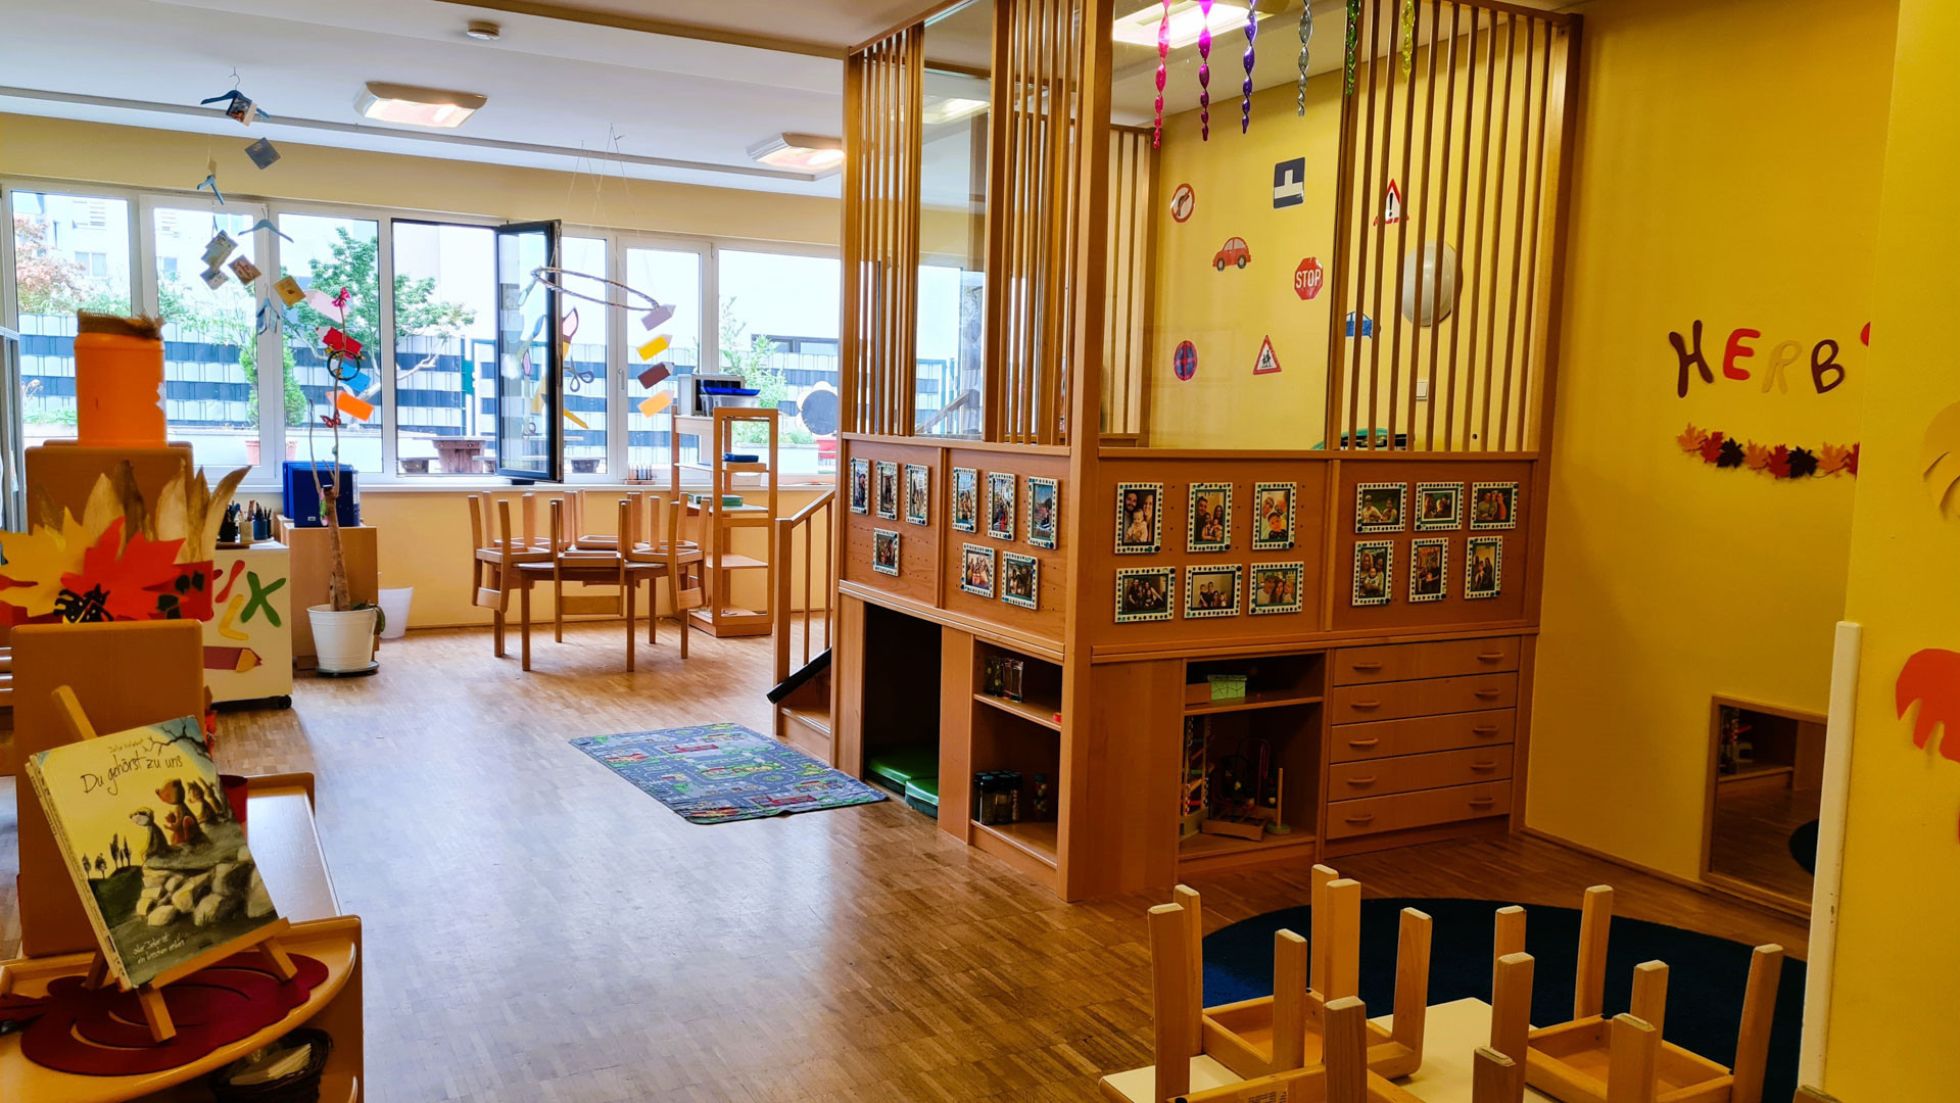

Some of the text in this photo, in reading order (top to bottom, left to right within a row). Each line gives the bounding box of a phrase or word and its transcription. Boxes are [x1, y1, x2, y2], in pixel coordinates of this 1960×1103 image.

[1295, 269, 1321, 289] STOP
[1668, 319, 1871, 398] HERB
[80, 749, 183, 796] Du gehörst zu uns
